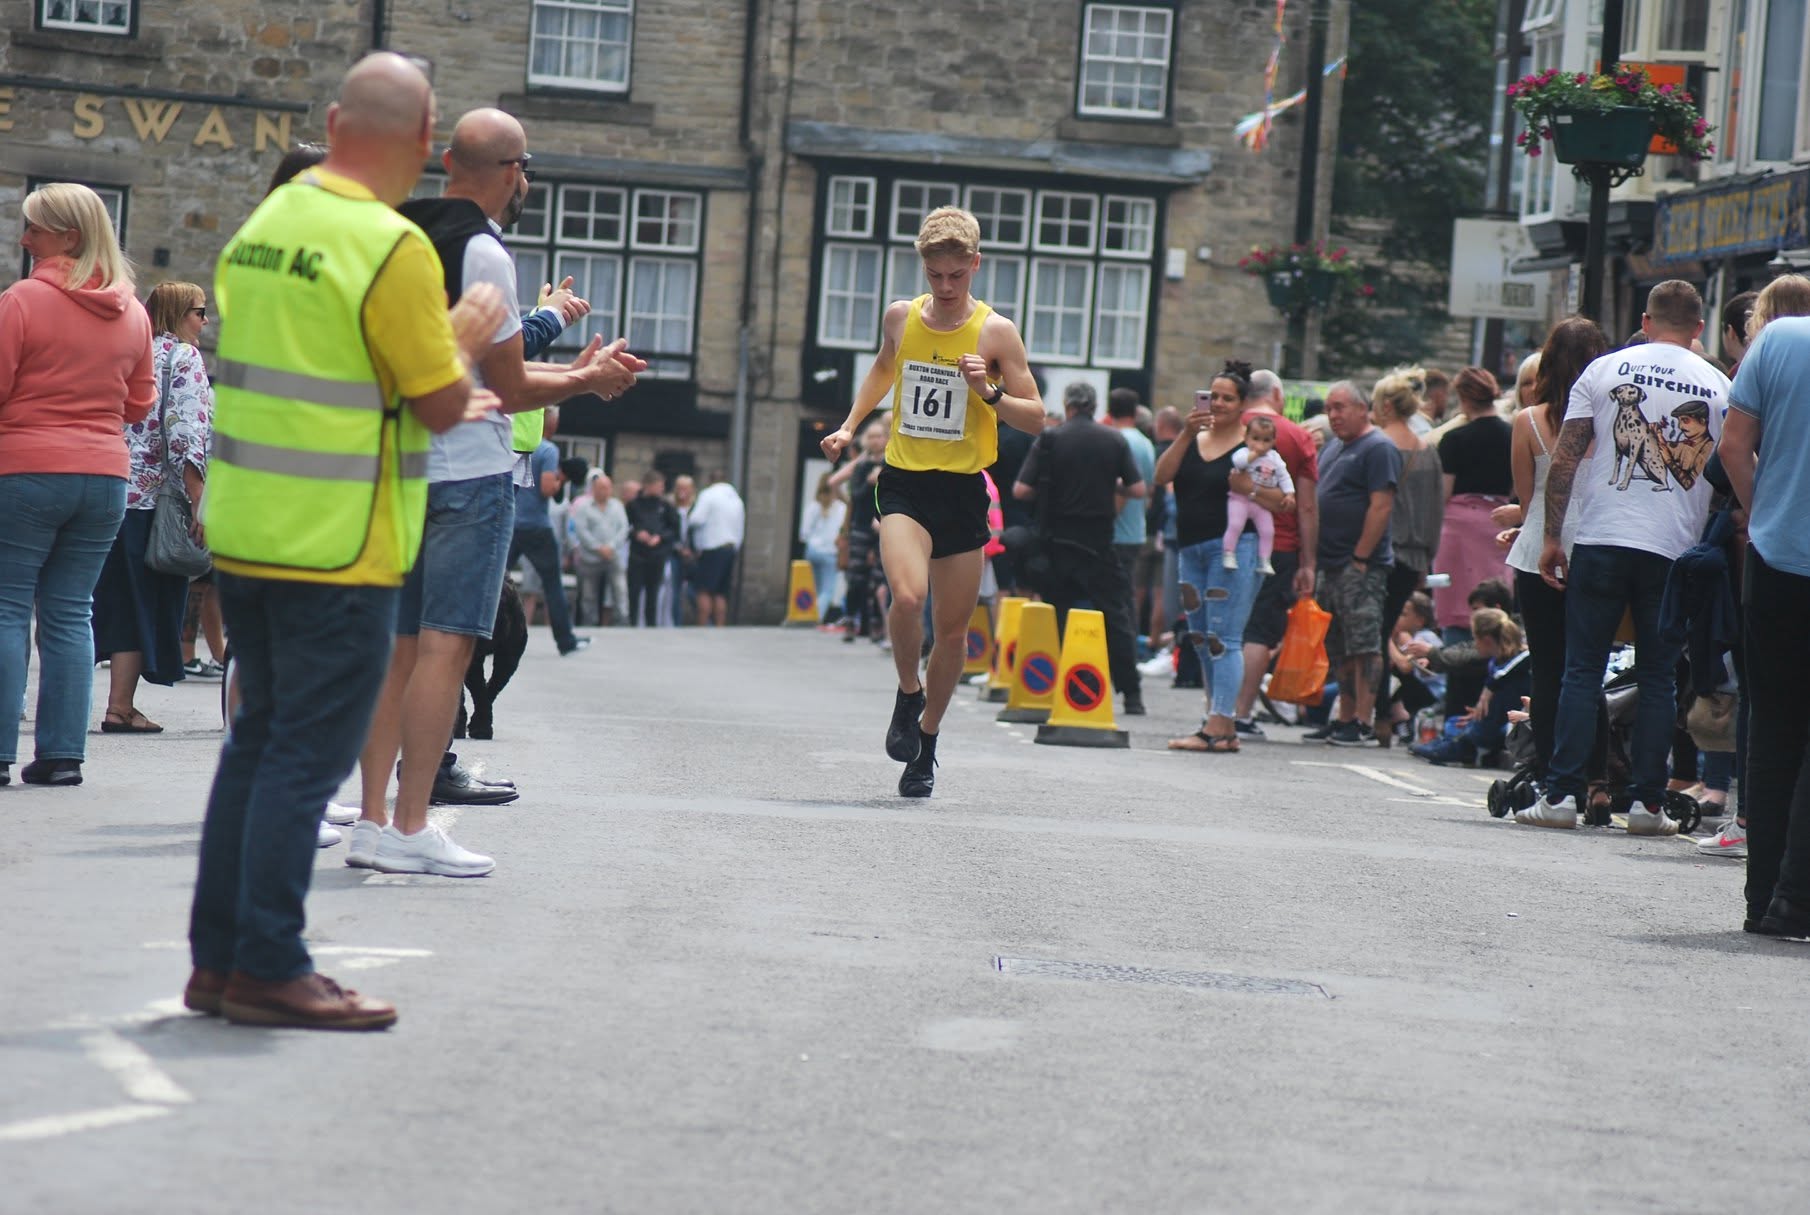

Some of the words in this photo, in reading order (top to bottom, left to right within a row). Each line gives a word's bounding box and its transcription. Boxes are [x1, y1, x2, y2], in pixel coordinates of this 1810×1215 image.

[73, 92, 293, 152] SWAN
[287, 246, 324, 283] AC
[909, 364, 929, 374] BUXTON
[930, 367, 957, 378] CARNIVAL
[919, 375, 935, 383] ROAD
[935, 377, 949, 386] RACE
[1649, 364, 1677, 376] YOUR
[1633, 373, 1718, 399] BITCHIN'
[913, 386, 952, 418] 161
